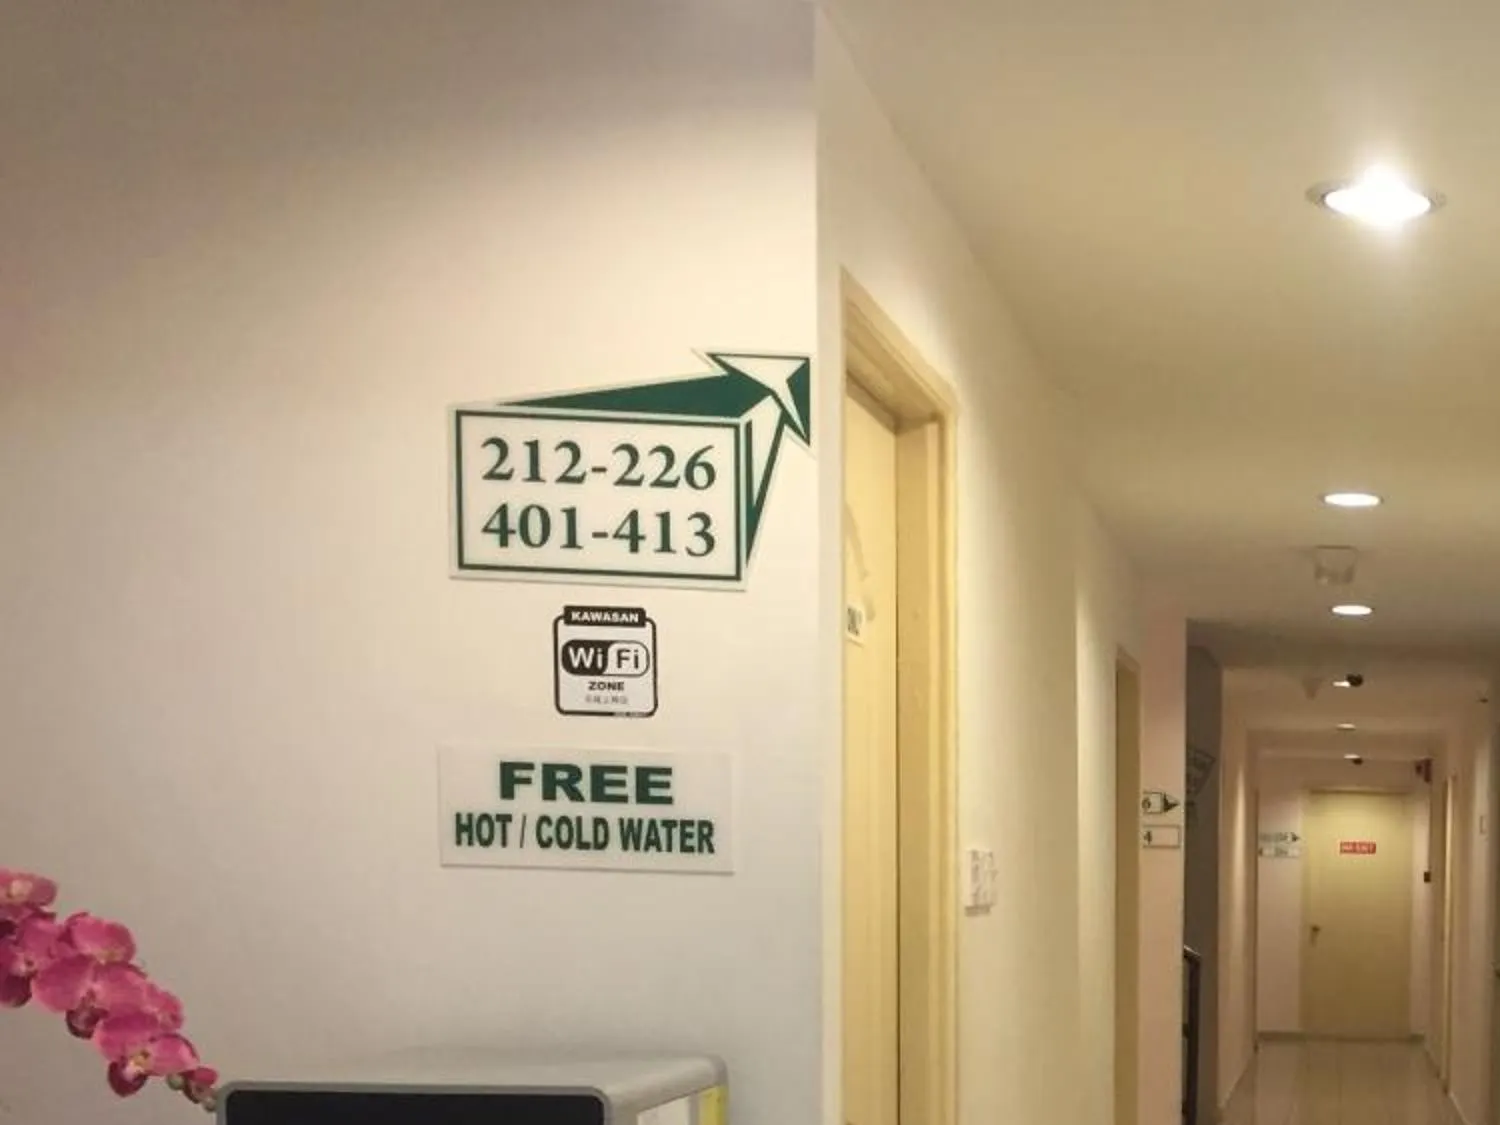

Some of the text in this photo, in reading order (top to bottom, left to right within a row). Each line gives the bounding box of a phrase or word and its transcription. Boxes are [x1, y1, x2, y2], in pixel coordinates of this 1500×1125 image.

[480, 436, 717, 491] 212-226
[480, 502, 716, 558] 401-413
[571, 610, 640, 623] KAWASAN
[587, 681, 625, 691] ZONE
[499, 761, 674, 805] FREE
[455, 812, 513, 848] HOT
[535, 814, 610, 851] COLD
[618, 817, 715, 854] WATER
